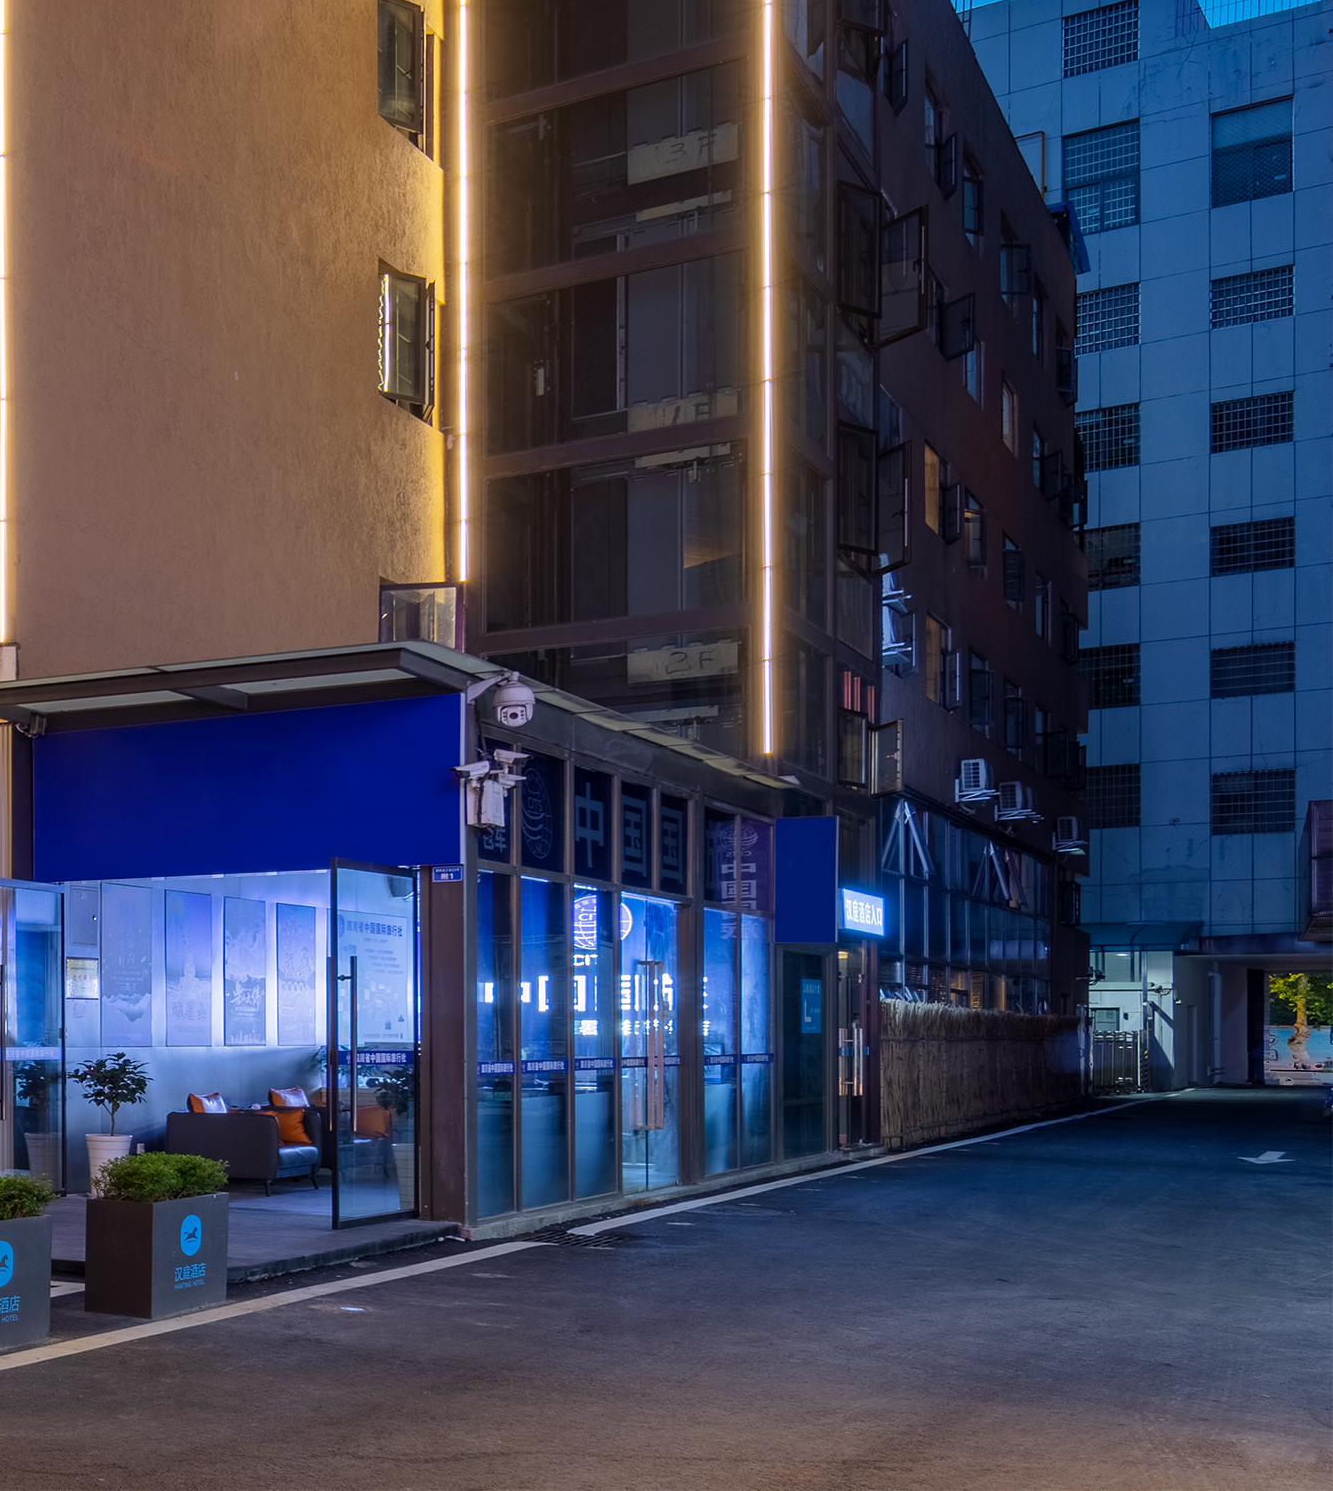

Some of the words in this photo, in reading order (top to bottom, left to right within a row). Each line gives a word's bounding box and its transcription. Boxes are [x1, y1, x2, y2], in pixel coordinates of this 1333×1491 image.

[845, 899, 883, 926] 汉庭酒店入口
[2, 1313, 19, 1322] HOTEL
